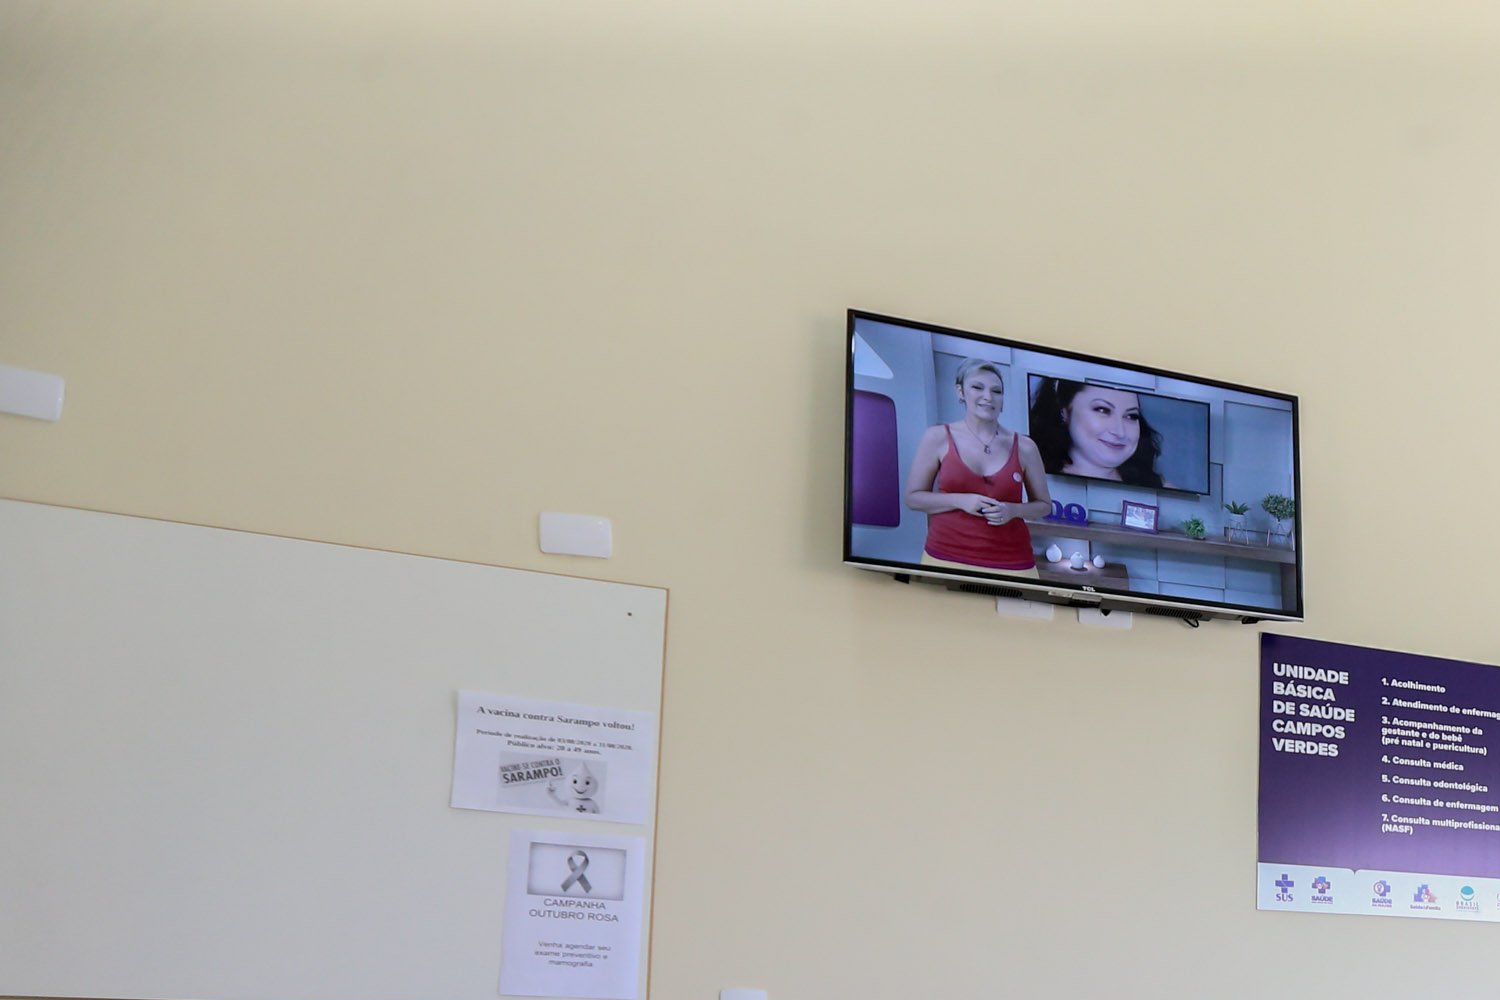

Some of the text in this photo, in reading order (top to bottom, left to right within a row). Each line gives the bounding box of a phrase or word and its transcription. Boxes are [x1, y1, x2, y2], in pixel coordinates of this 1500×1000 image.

[1273, 662, 1349, 685] UNIDADE
[1273, 680, 1336, 701] BÁSICA
[1381, 677, 1446, 693] 1. Acolhimento
[1273, 700, 1355, 722] DE SAÚDE
[1381, 696, 1390, 705] 2.
[1392, 698, 1448, 712] Atendimento
[1450, 706, 1460, 714] de
[477, 706, 635, 731] A vacina contra Sarampo voltou!
[1381, 716, 1483, 735] 3. Acompanhamento da
[1272, 719, 1346, 739] CAMPOS
[1381, 727, 1419, 737] gestante
[1429, 731, 1440, 740] do
[1442, 733, 1462, 743] bebê
[1272, 738, 1339, 757] VERDES
[1382, 736, 1399, 745] (pré
[1401, 738, 1423, 748] natal
[1433, 742, 1487, 755] puericultura)
[1381, 755, 1464, 771] 4. Consulta médica
[502, 766, 563, 784] SARAMPO!
[1381, 774, 1488, 793] 5. Consulta odontológica
[1381, 794, 1499, 813] 6. Consulta de enfermagem
[1381, 813, 1389, 822] 7.
[1391, 814, 1430, 825] Consulta
[1381, 823, 1413, 835] (NASF)
[543, 898, 606, 910] CAMPANHA
[1275, 893, 1294, 902] SUS
[1311, 895, 1333, 903] SAÚDE
[528, 909, 619, 922] OUTUBRO ROSA
